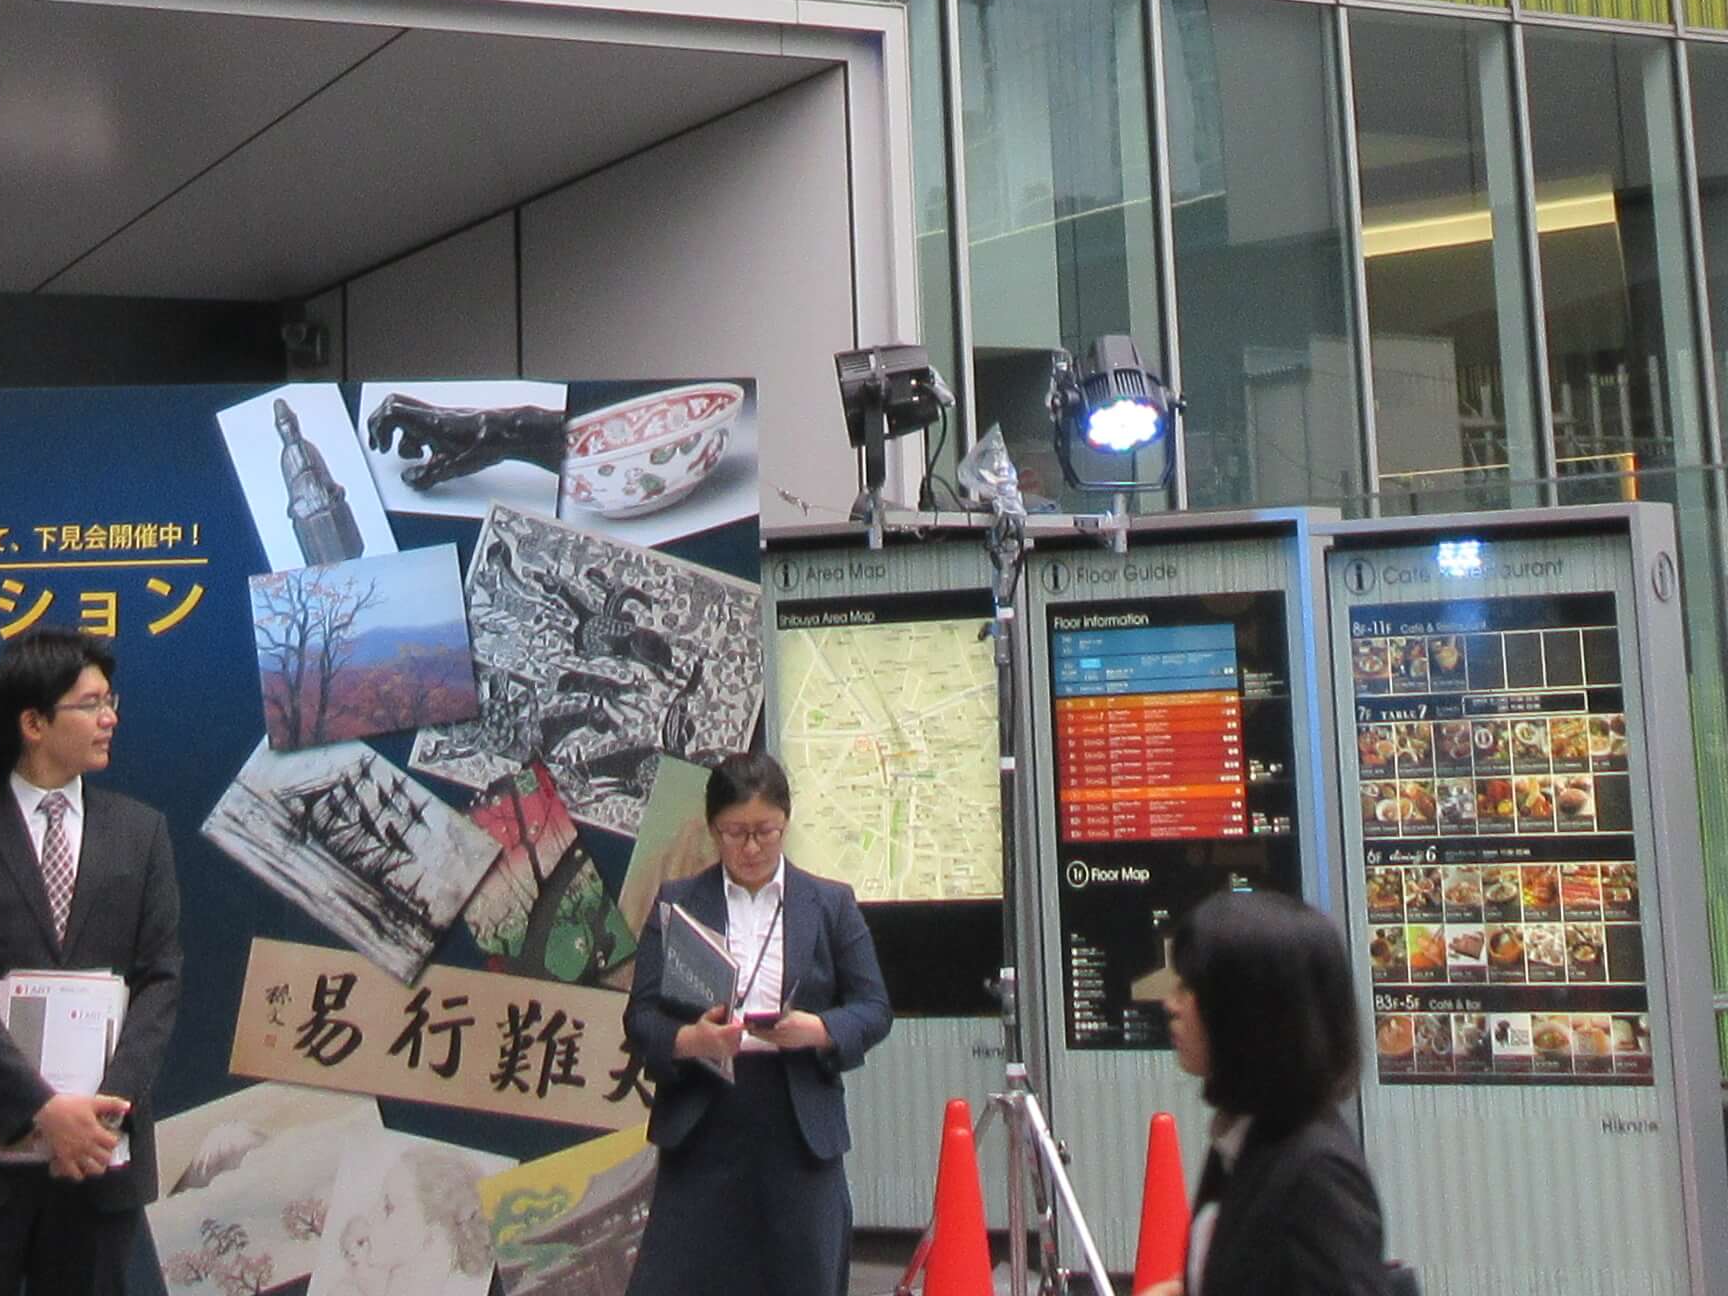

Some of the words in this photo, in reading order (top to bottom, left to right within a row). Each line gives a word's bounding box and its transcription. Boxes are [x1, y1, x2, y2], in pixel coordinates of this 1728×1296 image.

[805, 563, 844, 582] Area
[849, 561, 886, 582] Map
[1076, 566, 1118, 585] Floor
[1122, 561, 1178, 581] Guide
[779, 614, 821, 628] Shibuya
[822, 612, 849, 625] Area
[850, 611, 876, 626] Map
[1054, 615, 1081, 630] Floor
[1083, 612, 1150, 628] Information
[1091, 867, 1120, 882] Floor
[1121, 866, 1151, 884] Map
